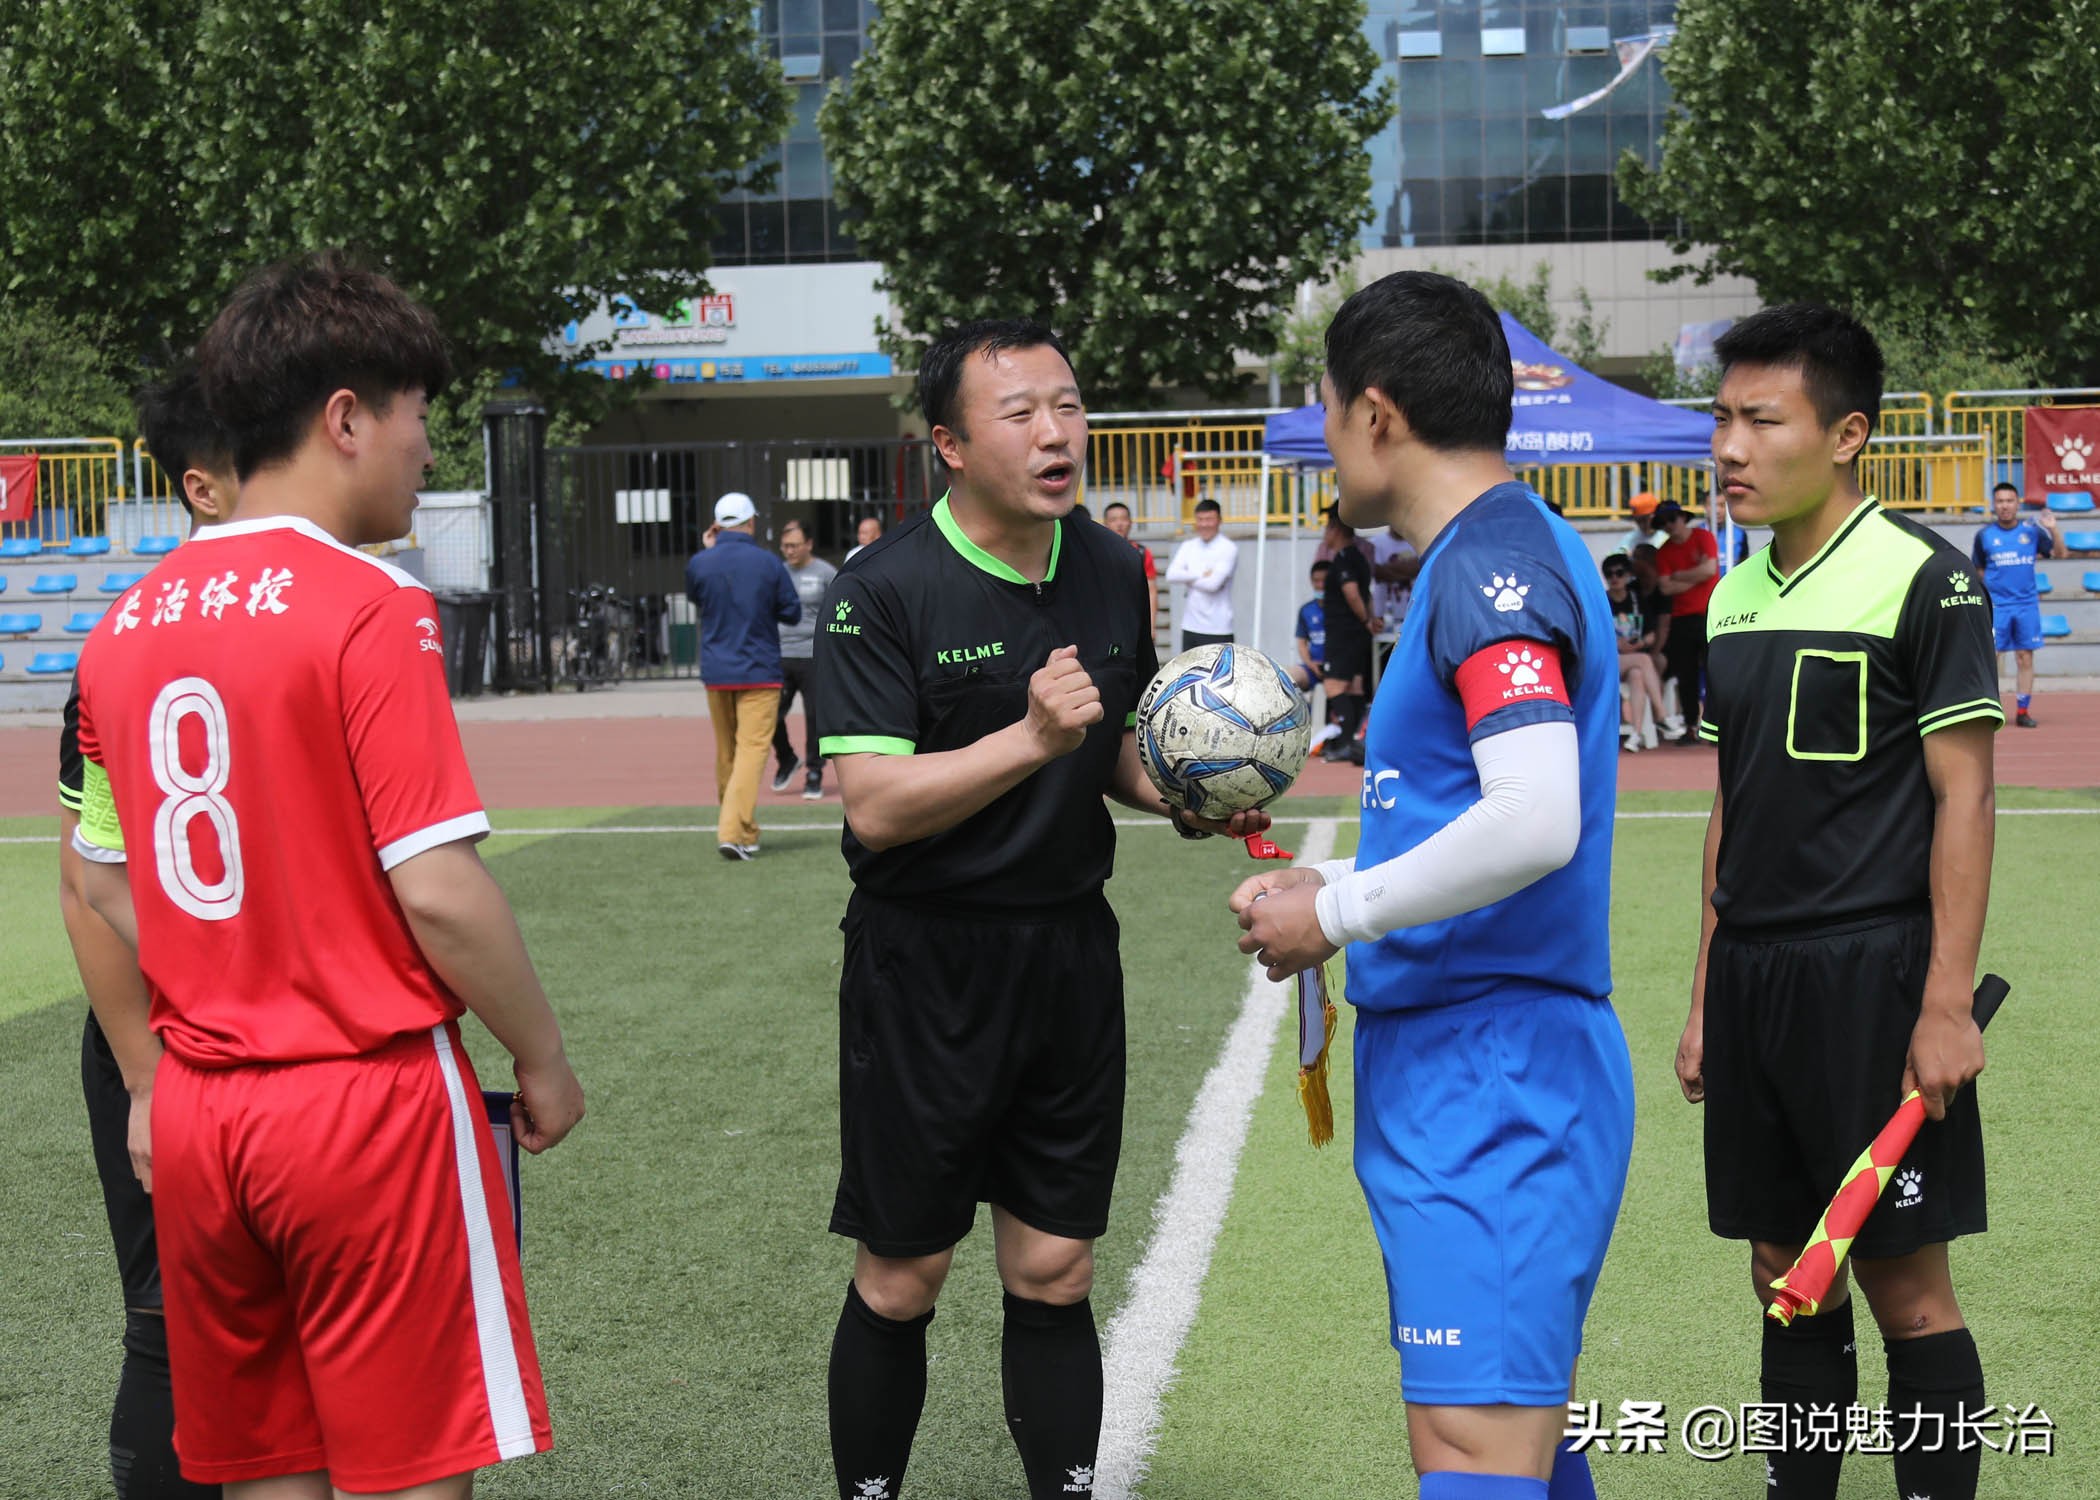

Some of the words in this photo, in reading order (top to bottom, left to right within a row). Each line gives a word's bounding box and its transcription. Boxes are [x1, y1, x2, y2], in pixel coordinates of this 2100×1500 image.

[2045, 473, 2100, 485] KELME
[114, 568, 294, 635] 长治体校
[1941, 595, 1983, 608] KELME
[1716, 611, 1758, 629] KELME
[937, 642, 1005, 664] KELME
[1502, 685, 1553, 699] KELME
[1138, 679, 1163, 765] molten
[149, 676, 244, 920] 8
